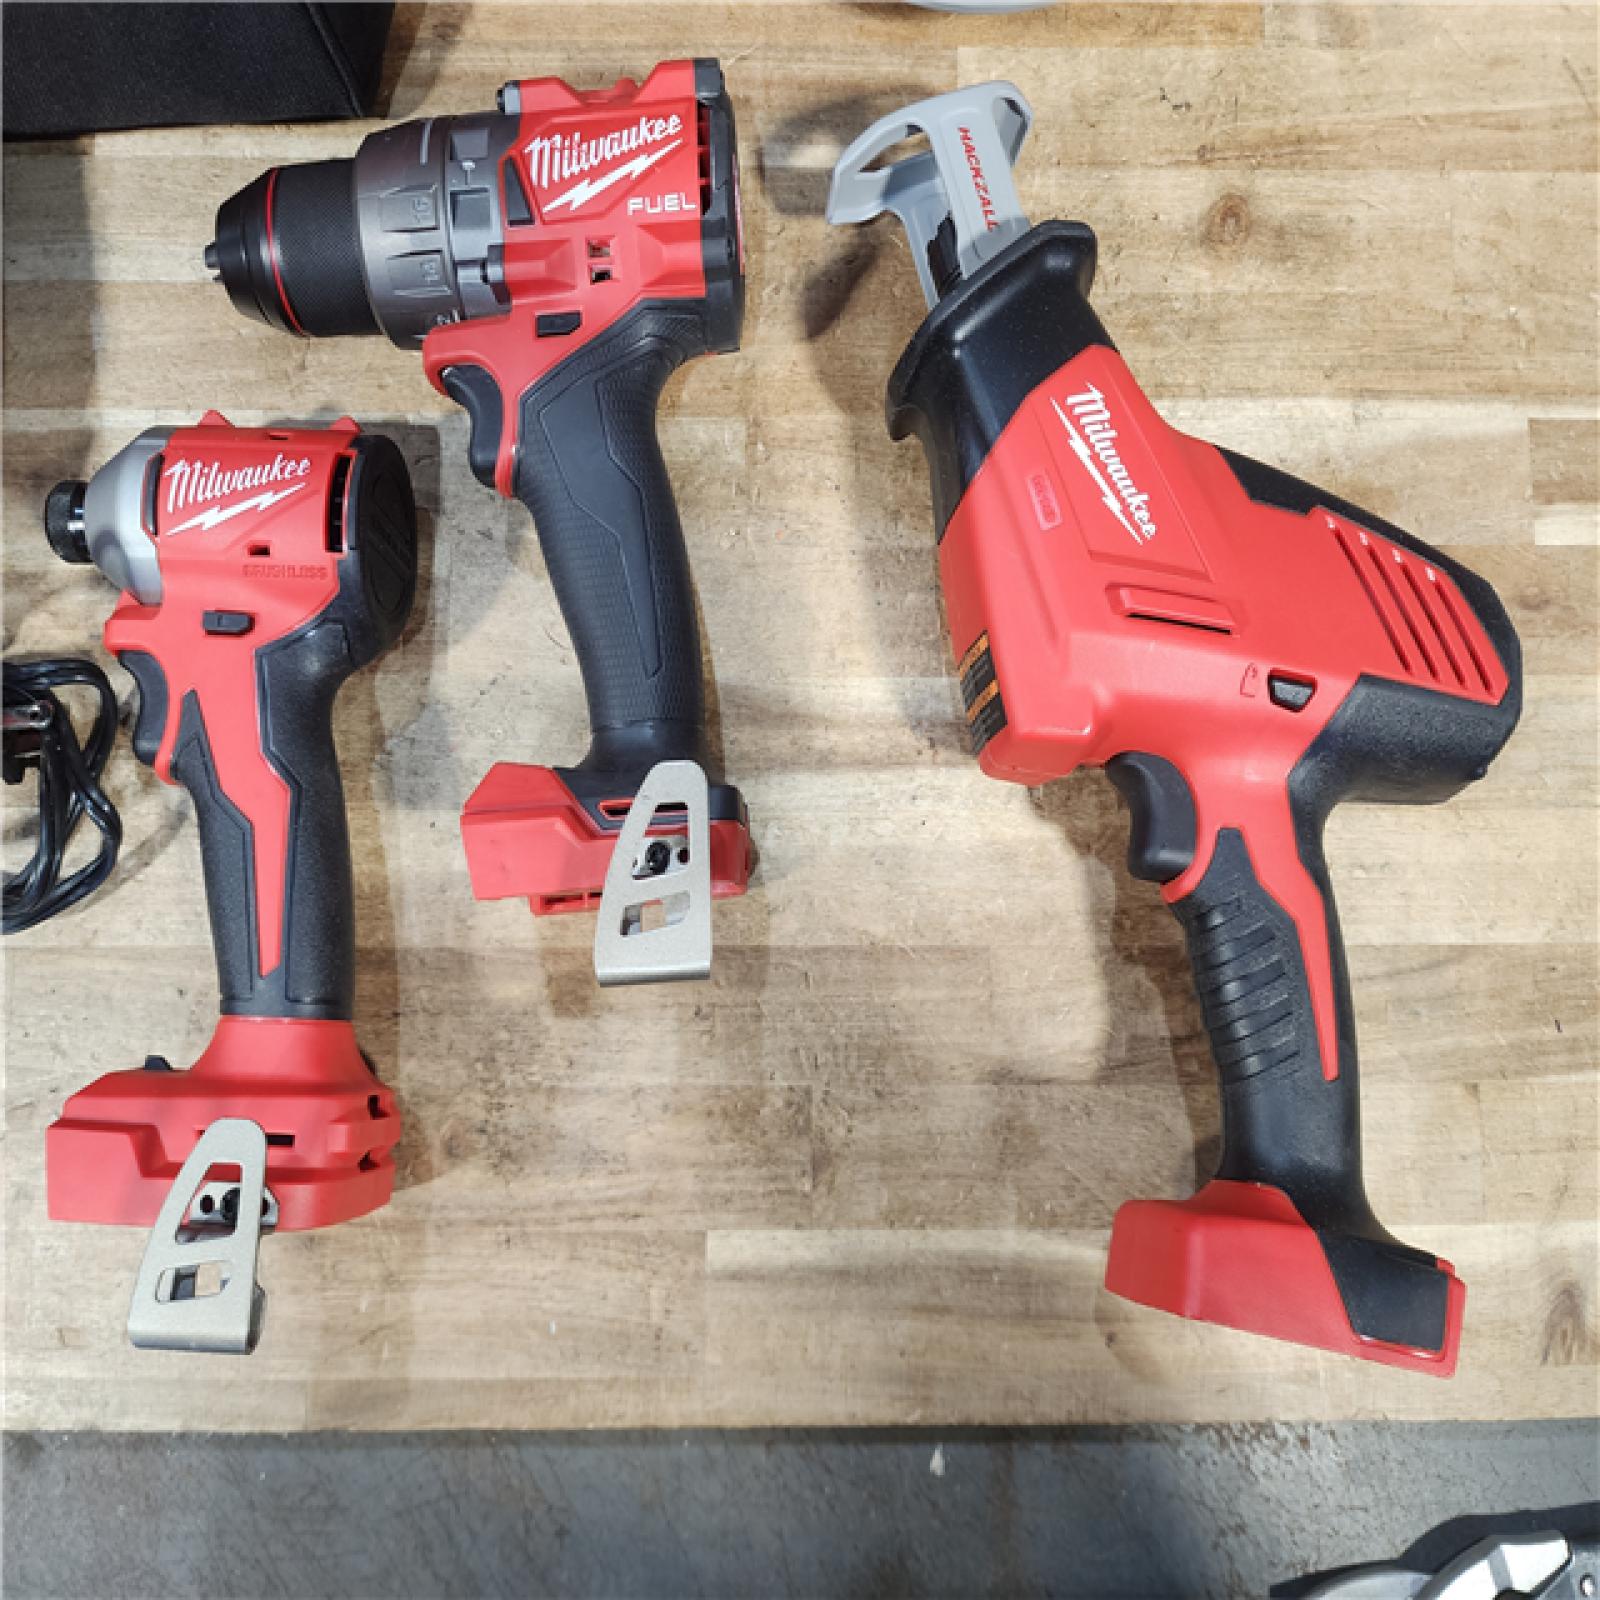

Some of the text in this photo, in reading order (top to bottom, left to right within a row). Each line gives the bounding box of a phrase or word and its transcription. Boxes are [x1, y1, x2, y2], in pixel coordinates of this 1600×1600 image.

[524, 114, 682, 189] Milwaukee
[957, 127, 999, 233] HACKZALL
[627, 192, 696, 216] FUEL
[165, 452, 311, 514] Milwaukee
[1066, 382, 1157, 540] Milwaukee
